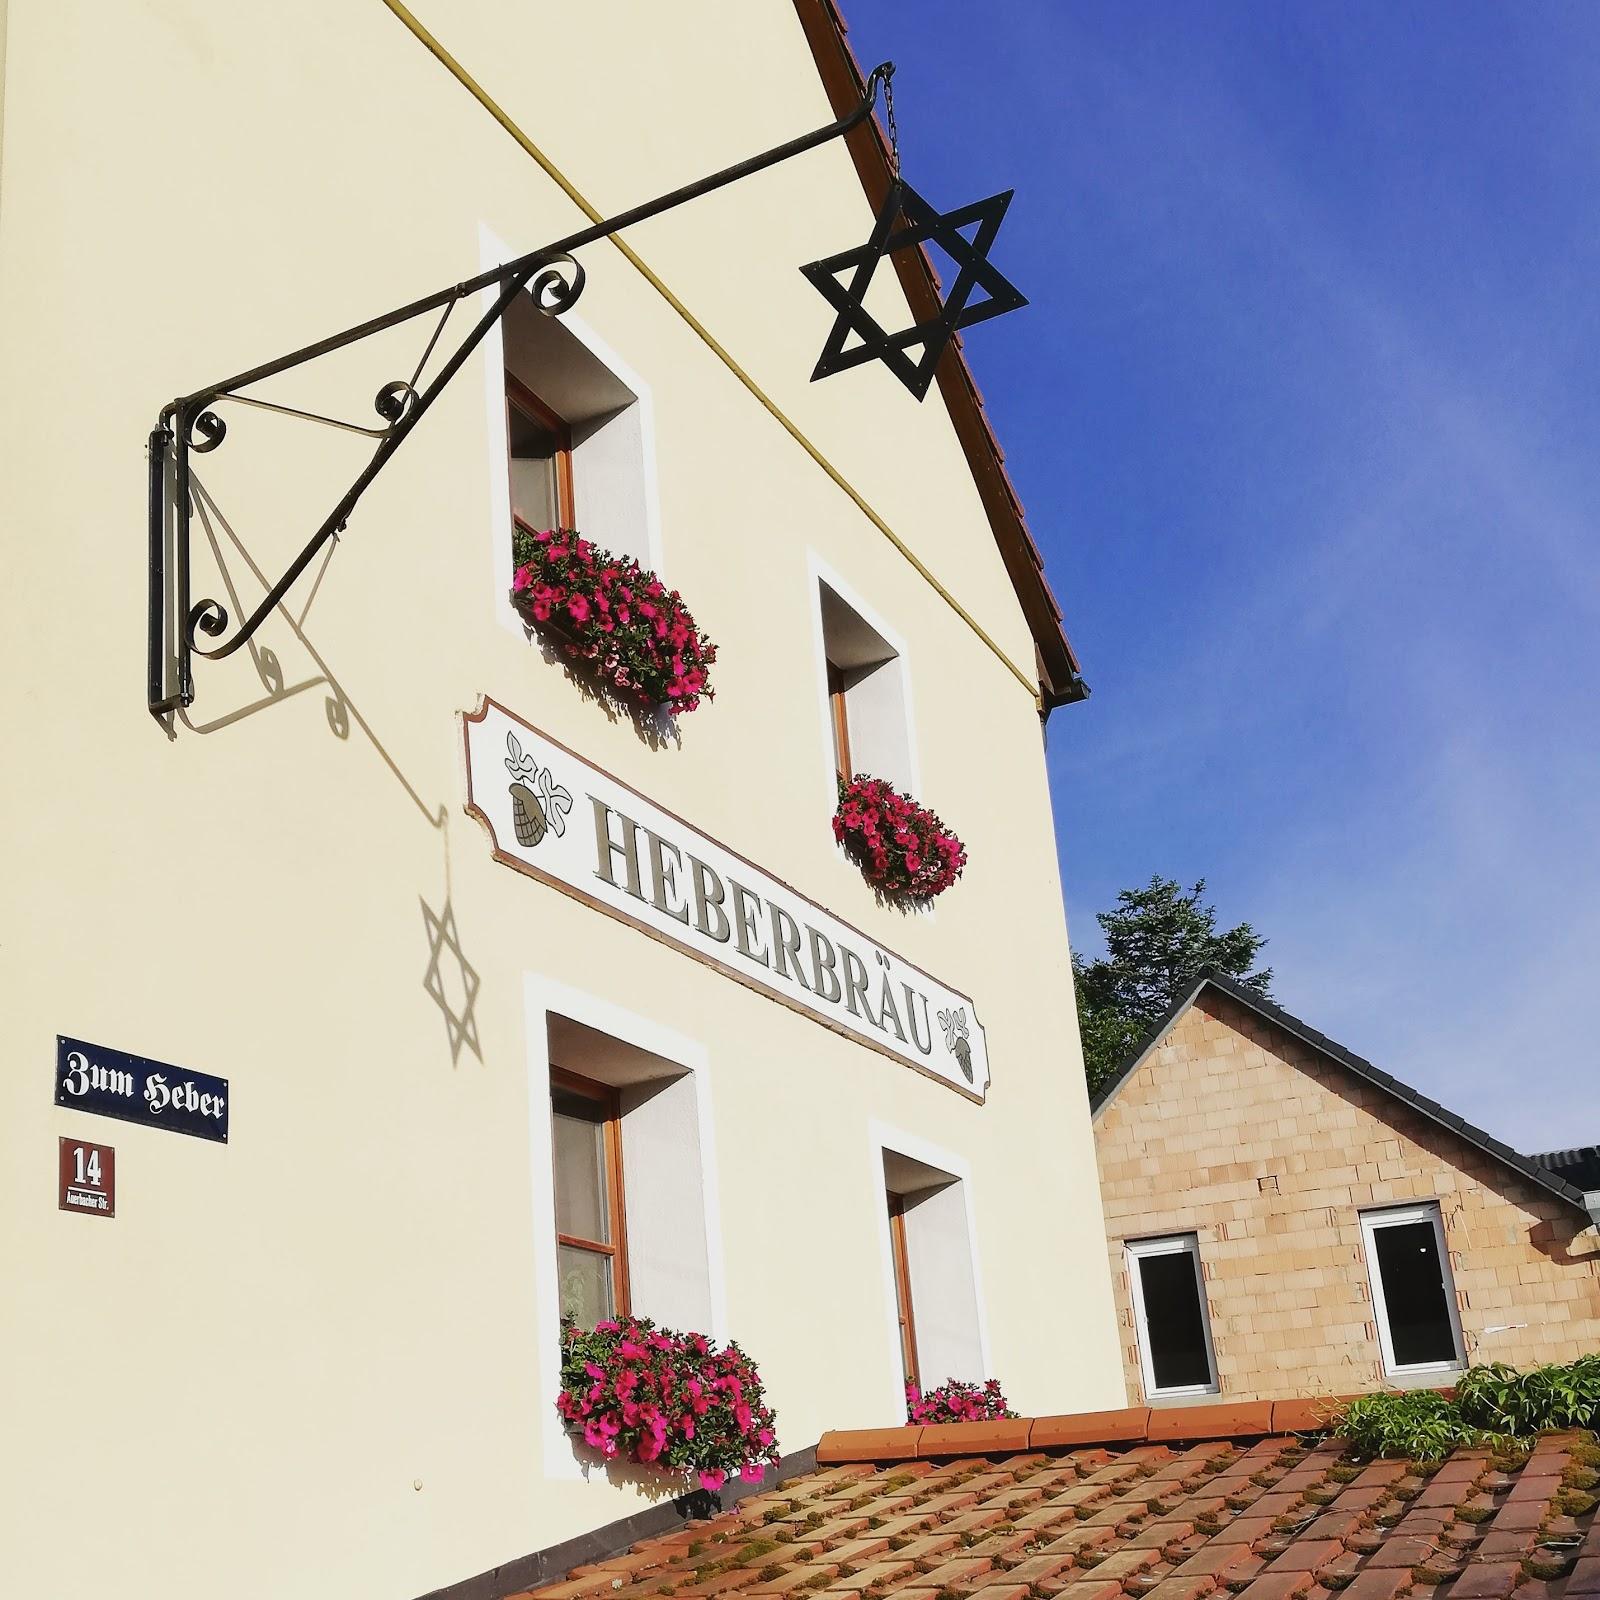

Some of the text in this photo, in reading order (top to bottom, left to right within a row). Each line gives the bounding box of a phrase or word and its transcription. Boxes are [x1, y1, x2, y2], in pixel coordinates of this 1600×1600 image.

[585, 792, 933, 1055] HEBERBRÄU
[63, 1051, 225, 1119] Zum Heber
[73, 1147, 102, 1186] 14
[66, 1191, 109, 1210] Auerbacher Str.
